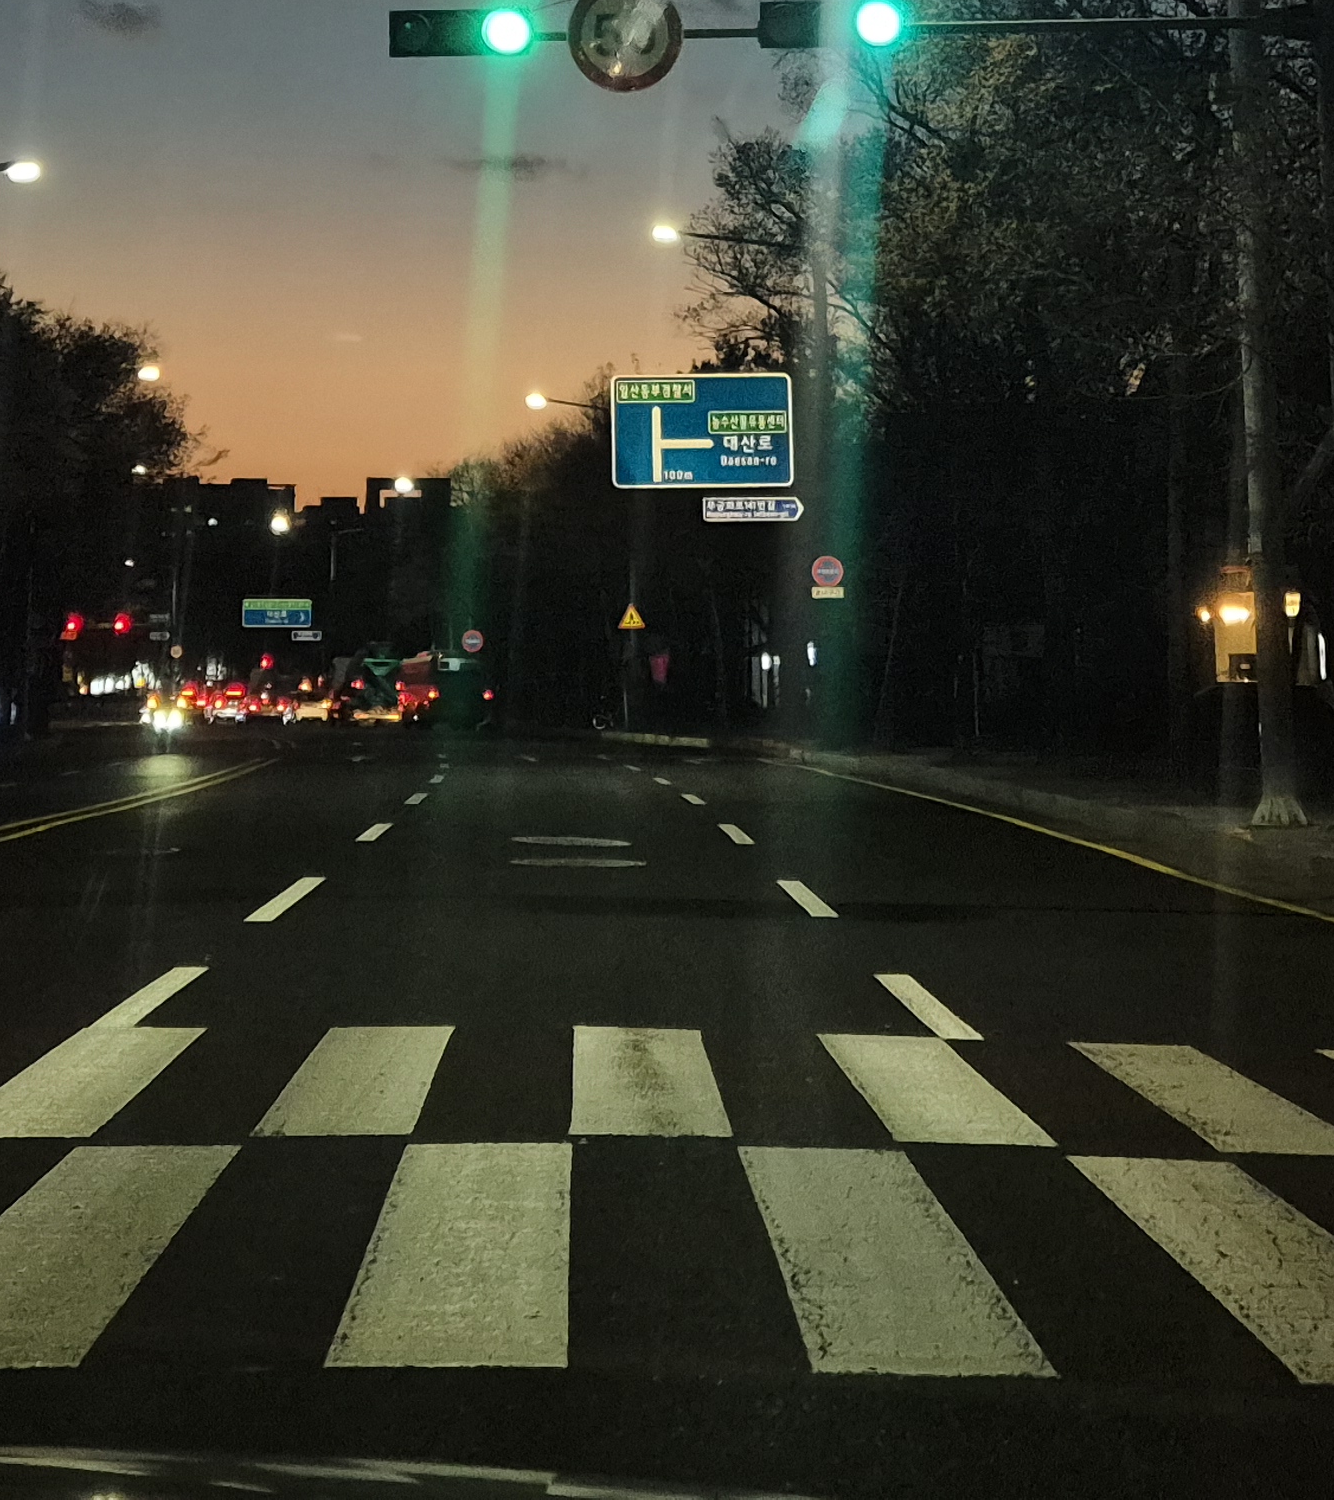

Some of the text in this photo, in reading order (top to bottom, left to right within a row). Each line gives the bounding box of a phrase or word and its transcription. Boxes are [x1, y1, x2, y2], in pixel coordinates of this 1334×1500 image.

[619, 383, 692, 399] 일산동부경찰서
[711, 414, 785, 430] 농수산물유통센터
[723, 435, 773, 453] 대산로
[720, 455, 777, 467] Daesan-ro
